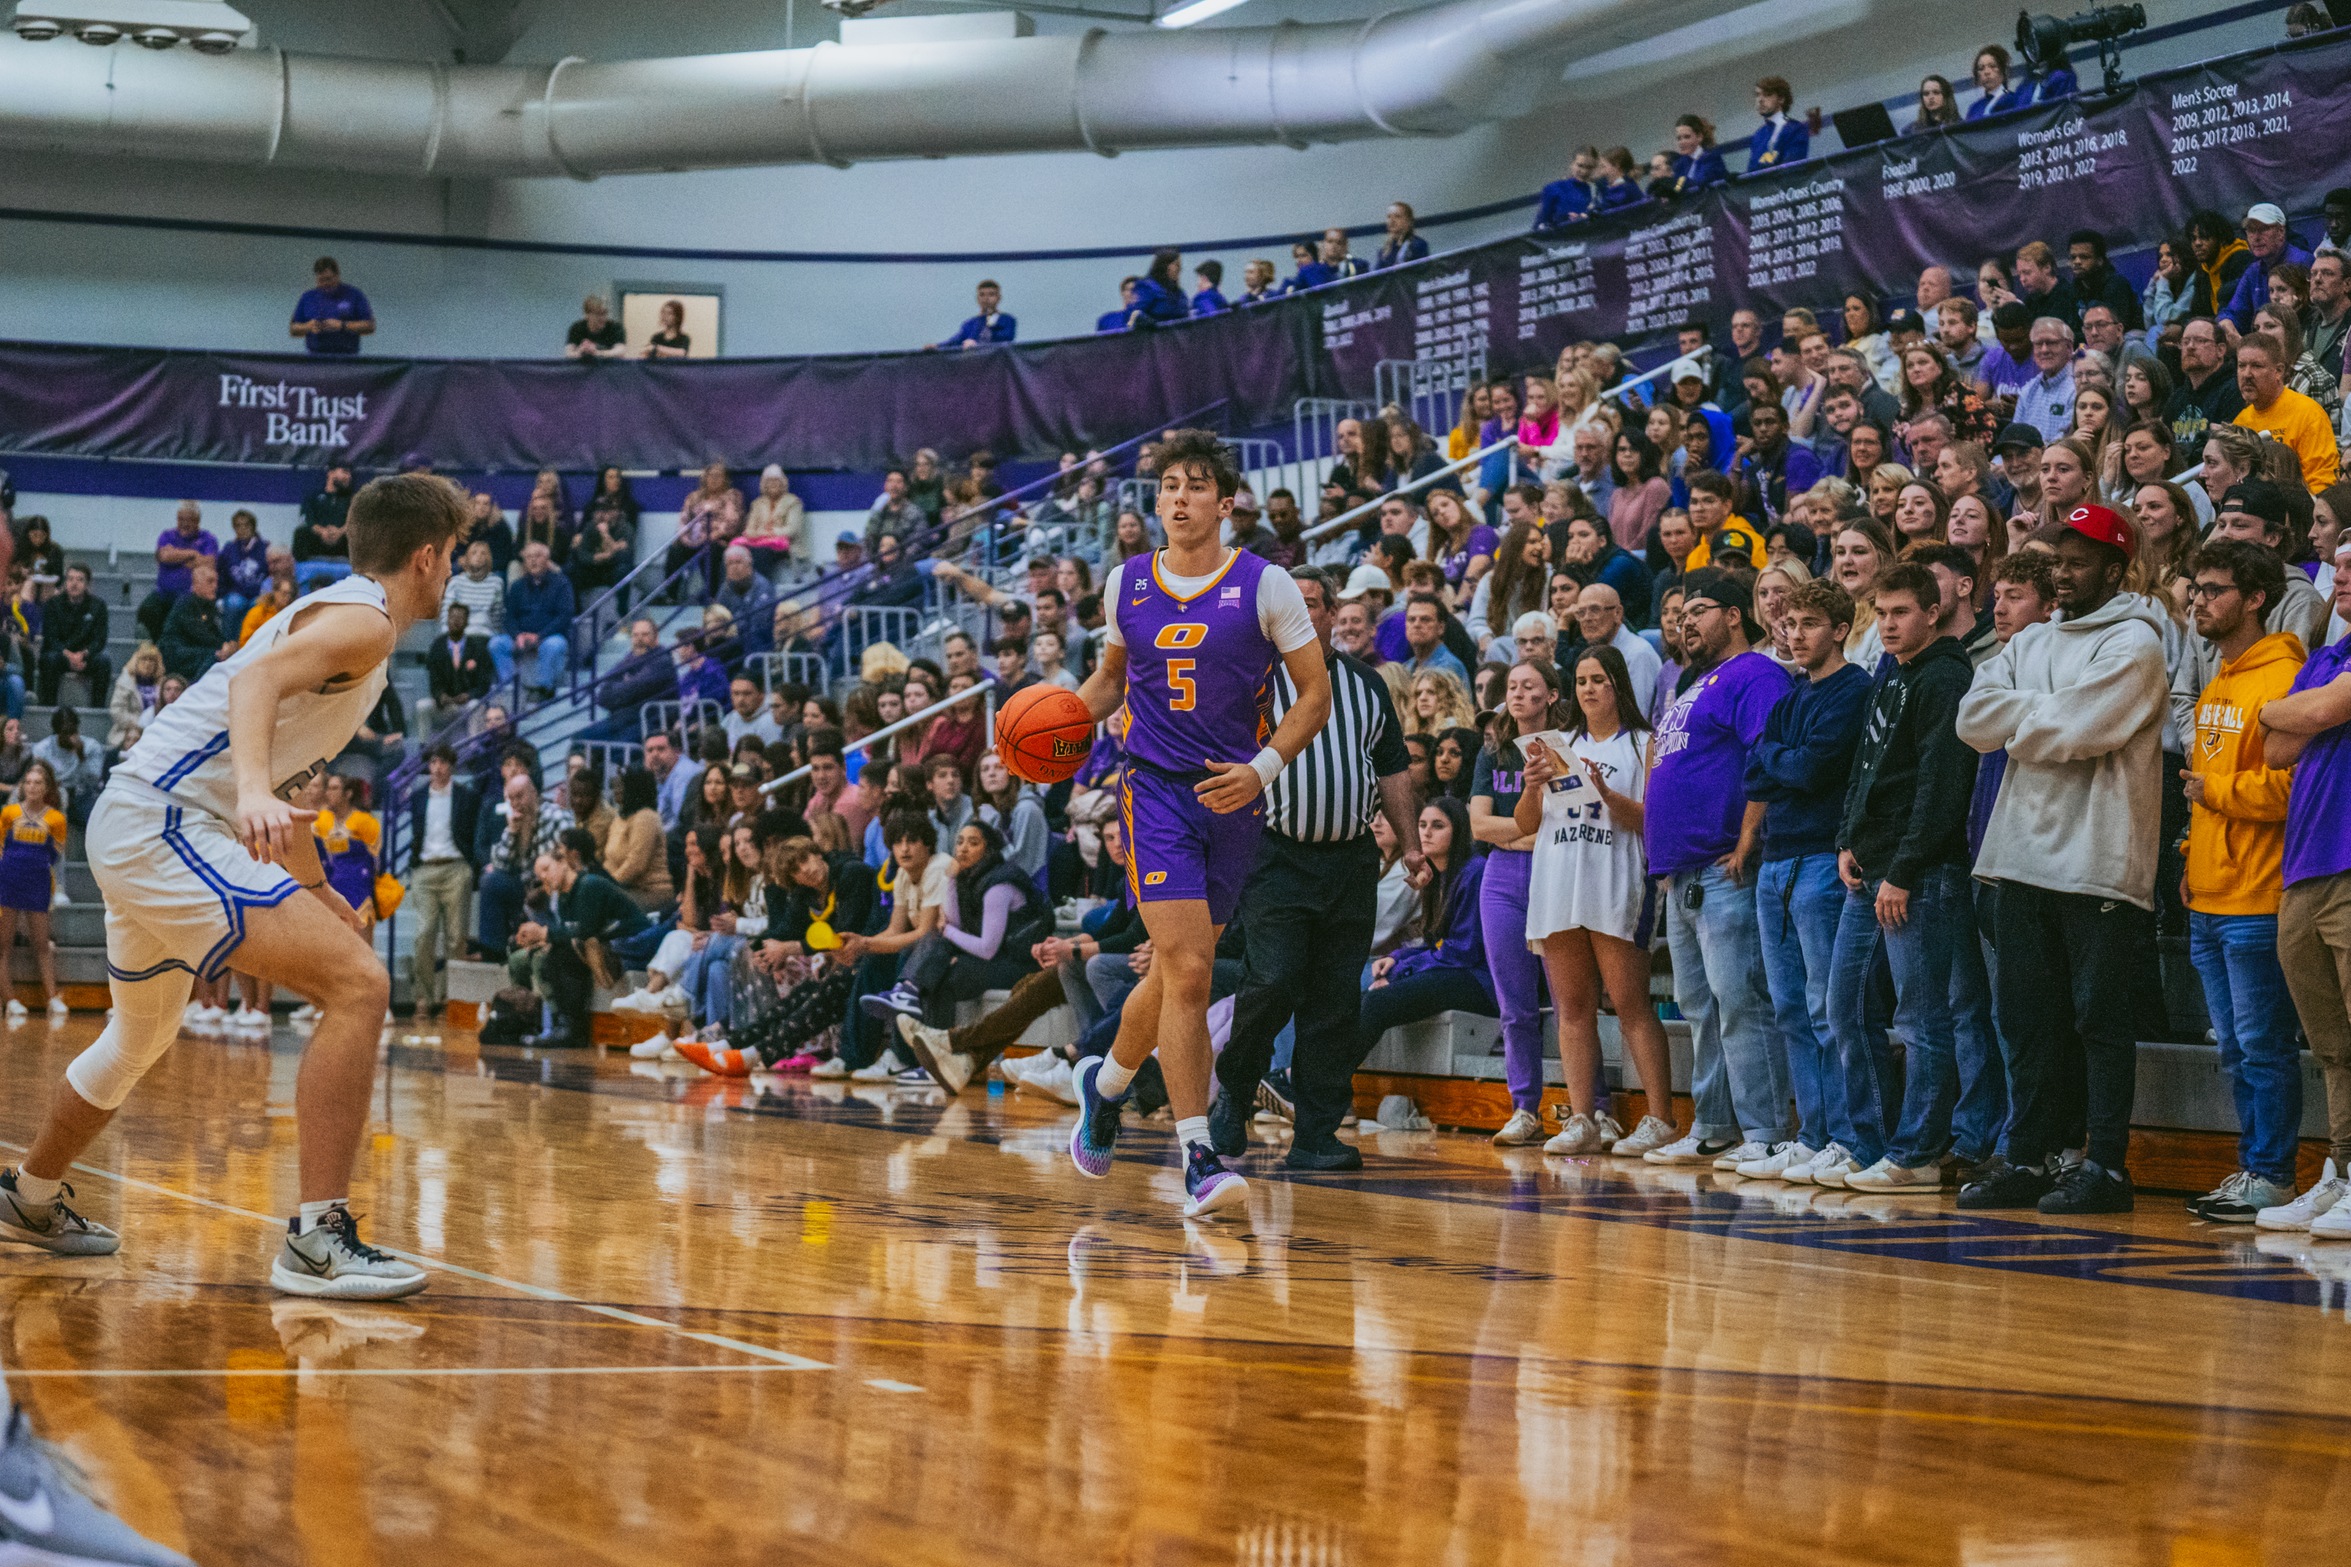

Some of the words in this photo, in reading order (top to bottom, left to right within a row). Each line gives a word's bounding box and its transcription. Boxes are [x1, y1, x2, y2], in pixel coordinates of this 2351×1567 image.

[2172, 88, 2202, 110] Men's
[2203, 83, 2238, 103] Soccer
[2172, 112, 2200, 132] 2009,
[2202, 105, 2230, 125] 2012,
[2231, 98, 2260, 118] 2013,
[2262, 90, 2292, 111] 2014,
[2018, 124, 2062, 147] Women's
[2063, 117, 2085, 137] Golf
[2171, 134, 2200, 154] 2016,
[2201, 127, 2228, 148] 2017,
[2262, 115, 2291, 135] 2021,
[2018, 150, 2044, 169] 2013,
[2046, 143, 2073, 162] 2014,
[2074, 136, 2099, 156] 2016,
[2100, 129, 2129, 150] 2018,
[1933, 171, 1956, 190] 2020
[2018, 170, 2045, 190] 2019,
[2046, 165, 2073, 184] 2021,
[2074, 158, 2096, 177] 2022
[2171, 156, 2198, 176] 2022
[265, 412, 350, 447] Bank
[2069, 507, 2090, 521] C
[1135, 578, 1148, 591] 25
[1166, 658, 1197, 712] 5
